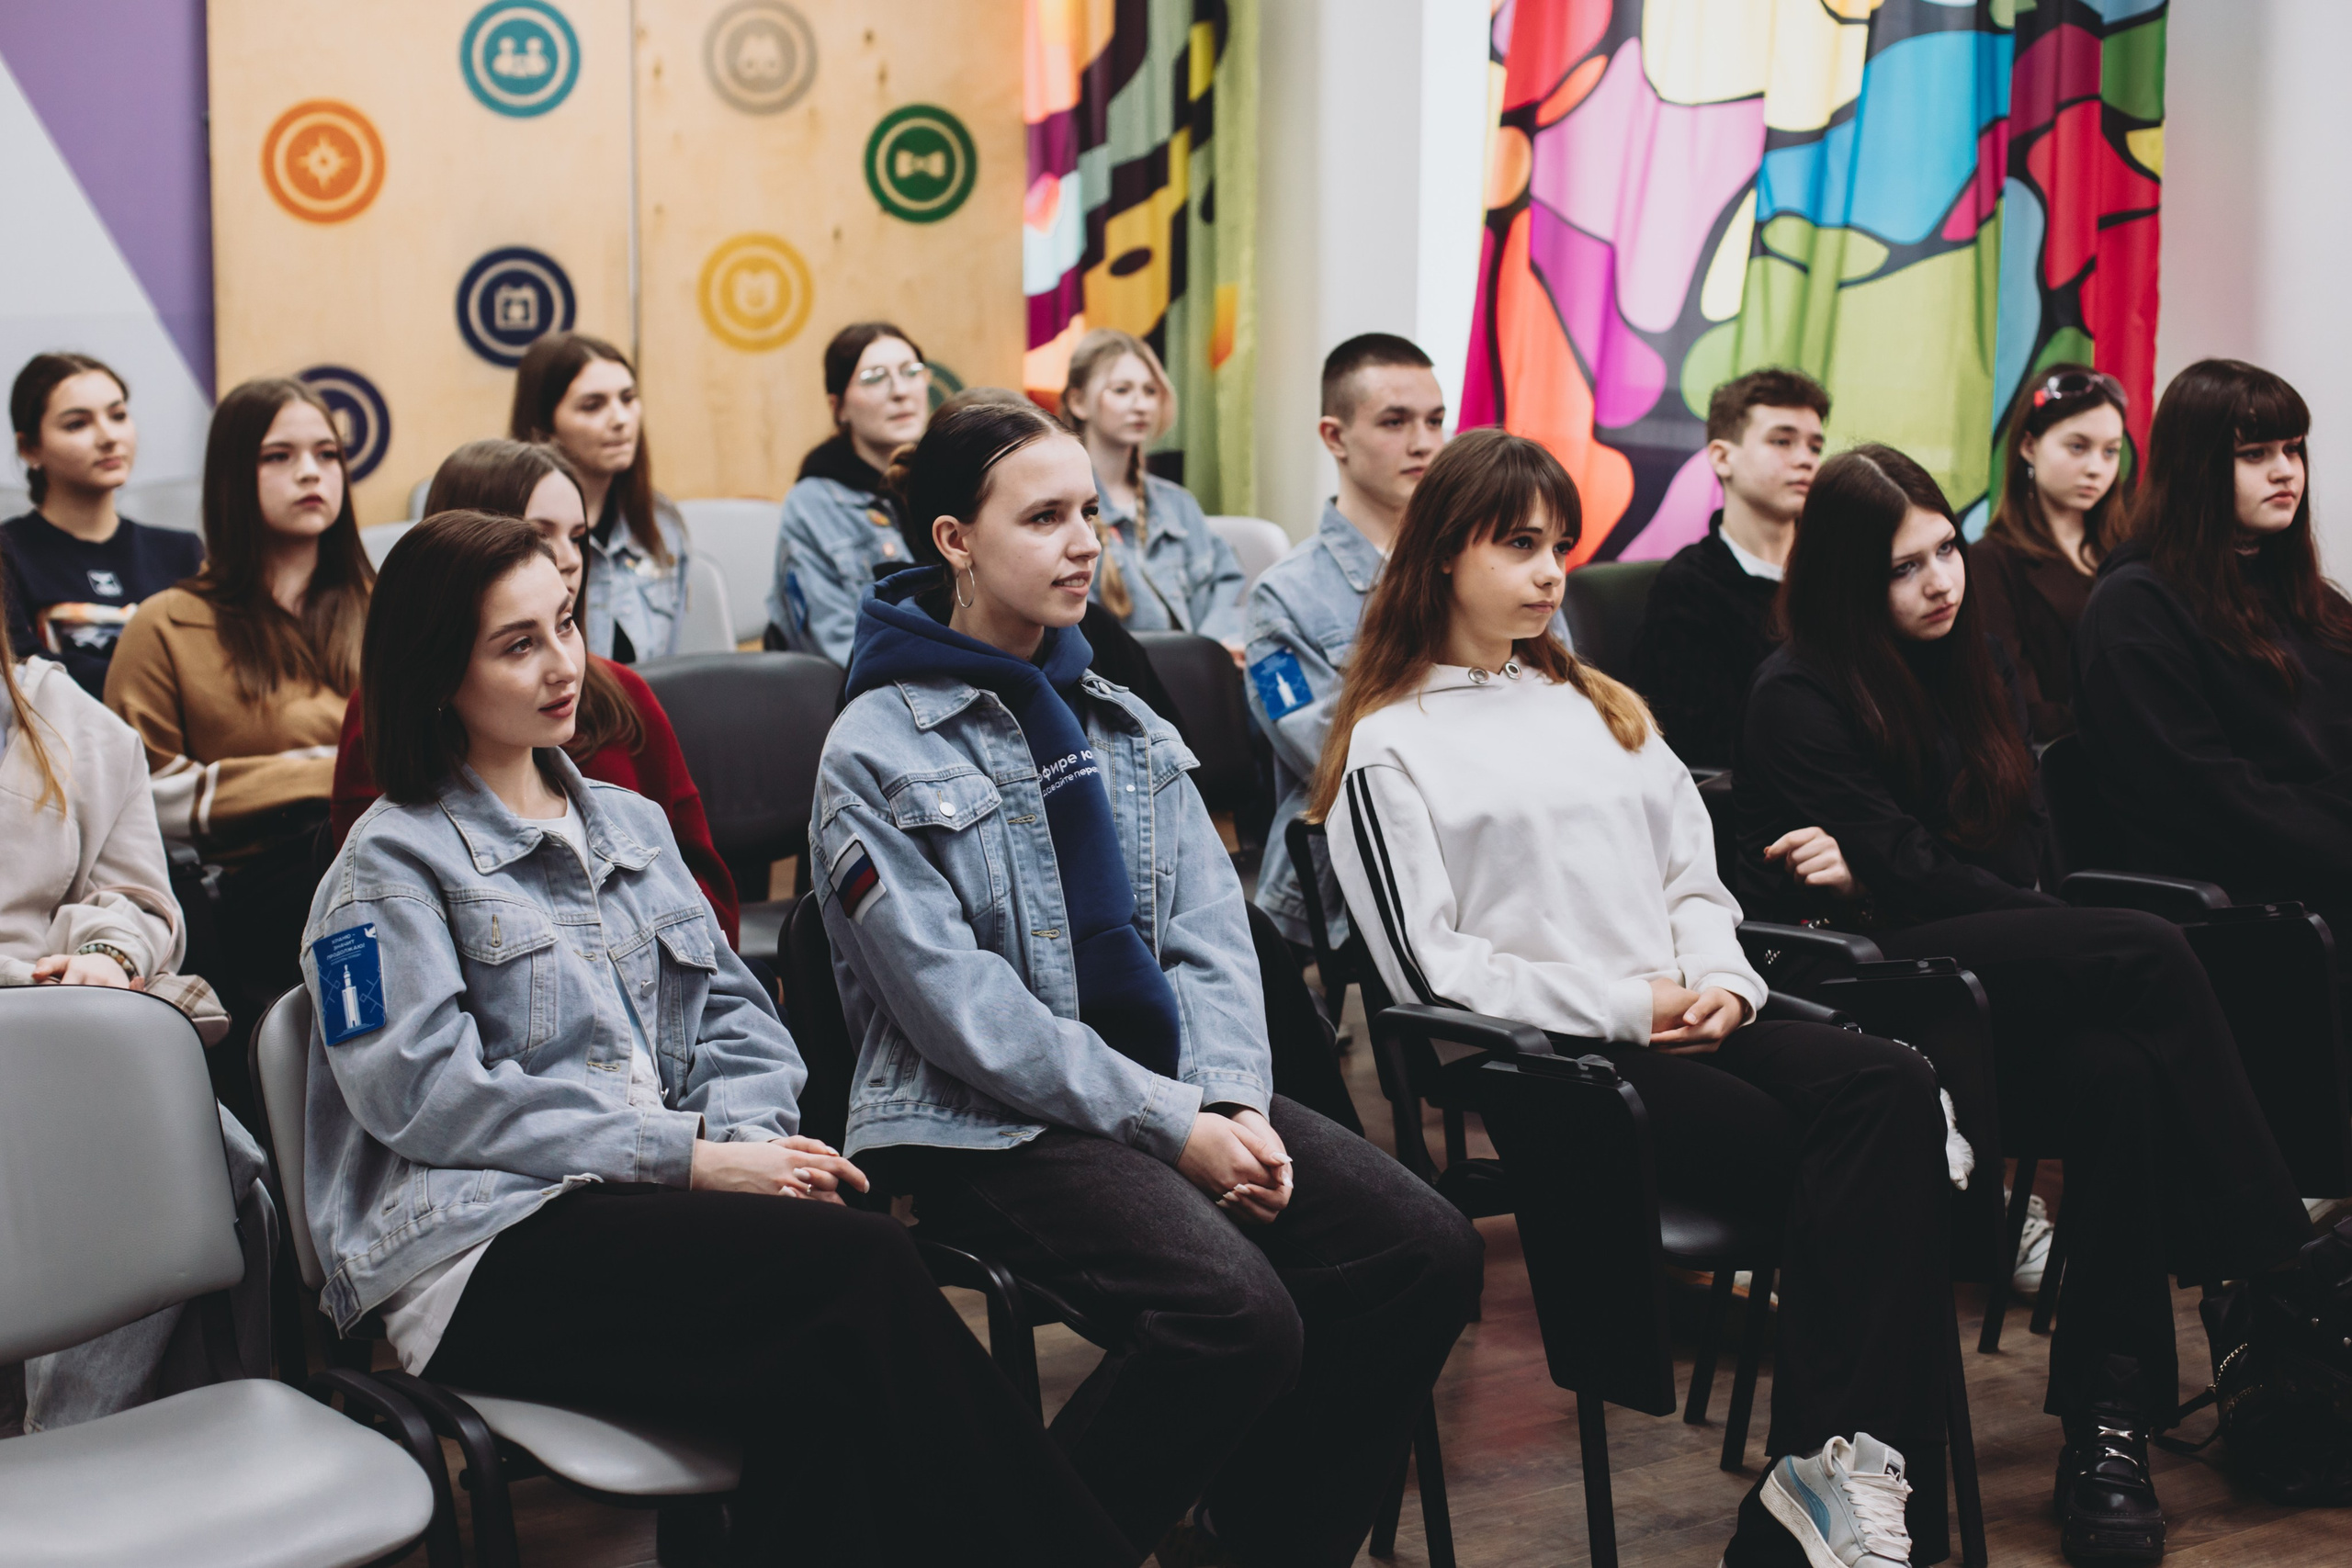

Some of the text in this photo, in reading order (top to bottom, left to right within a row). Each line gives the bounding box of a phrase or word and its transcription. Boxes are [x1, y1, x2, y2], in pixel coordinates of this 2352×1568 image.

[1073, 766, 1100, 779] пере
[326, 942, 366, 961] ПРОДОЛЖАЮ!
[334, 939, 355, 951] ЗНАЧИТ
